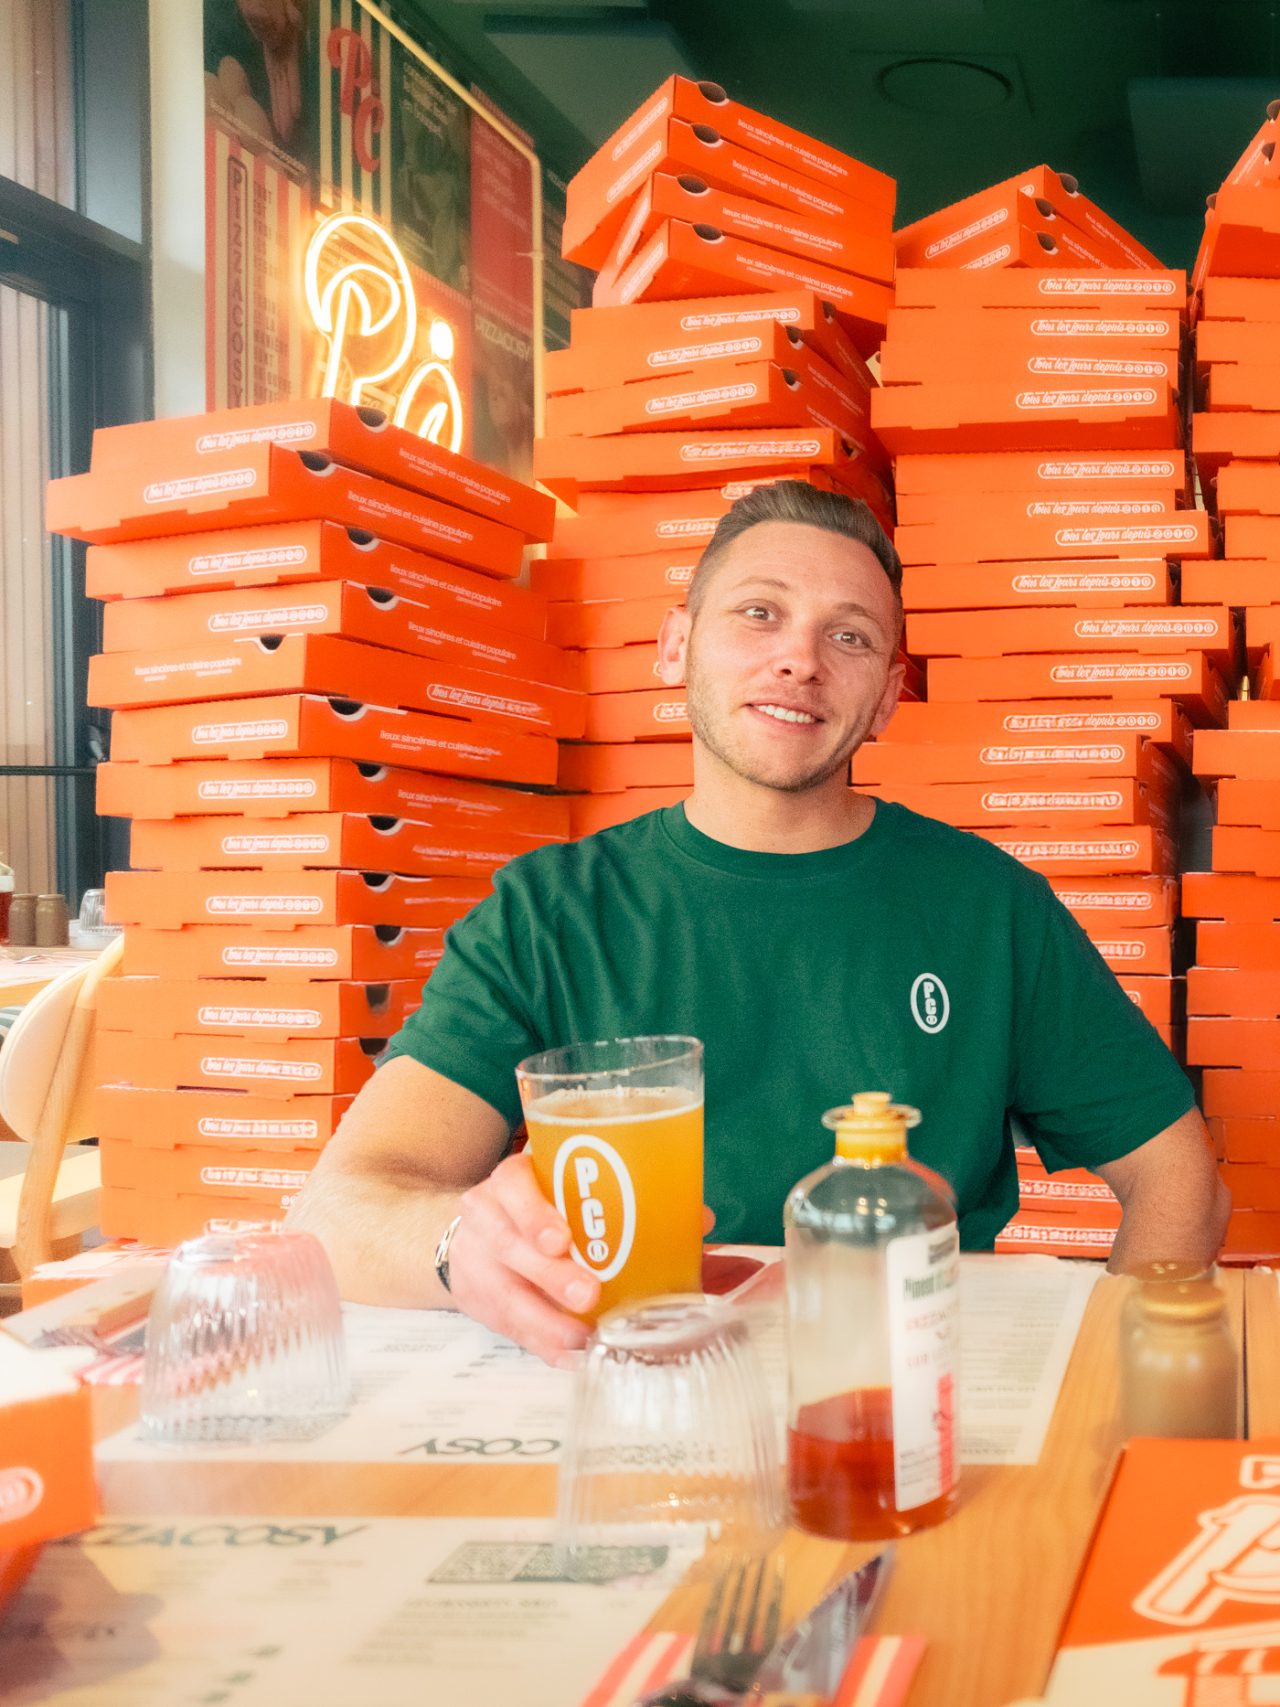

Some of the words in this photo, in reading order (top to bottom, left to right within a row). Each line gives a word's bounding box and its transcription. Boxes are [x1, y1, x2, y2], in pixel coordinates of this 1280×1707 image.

[1044, 279, 1062, 291] Tous
[1103, 279, 1133, 293] depuis
[1036, 320, 1054, 332] Tous
[1095, 321, 1125, 335] depuis
[1034, 358, 1051, 369] Tous
[1093, 360, 1123, 374] depuis
[1021, 393, 1039, 405] Tous
[1081, 390, 1112, 405] depuis
[1061, 529, 1079, 541] Tous
[1121, 527, 1152, 542] depuis
[1018, 575, 1036, 588] Tous
[1078, 574, 1110, 590] depuis
[1080, 621, 1098, 633] Tous
[1141, 620, 1172, 635] depuis
